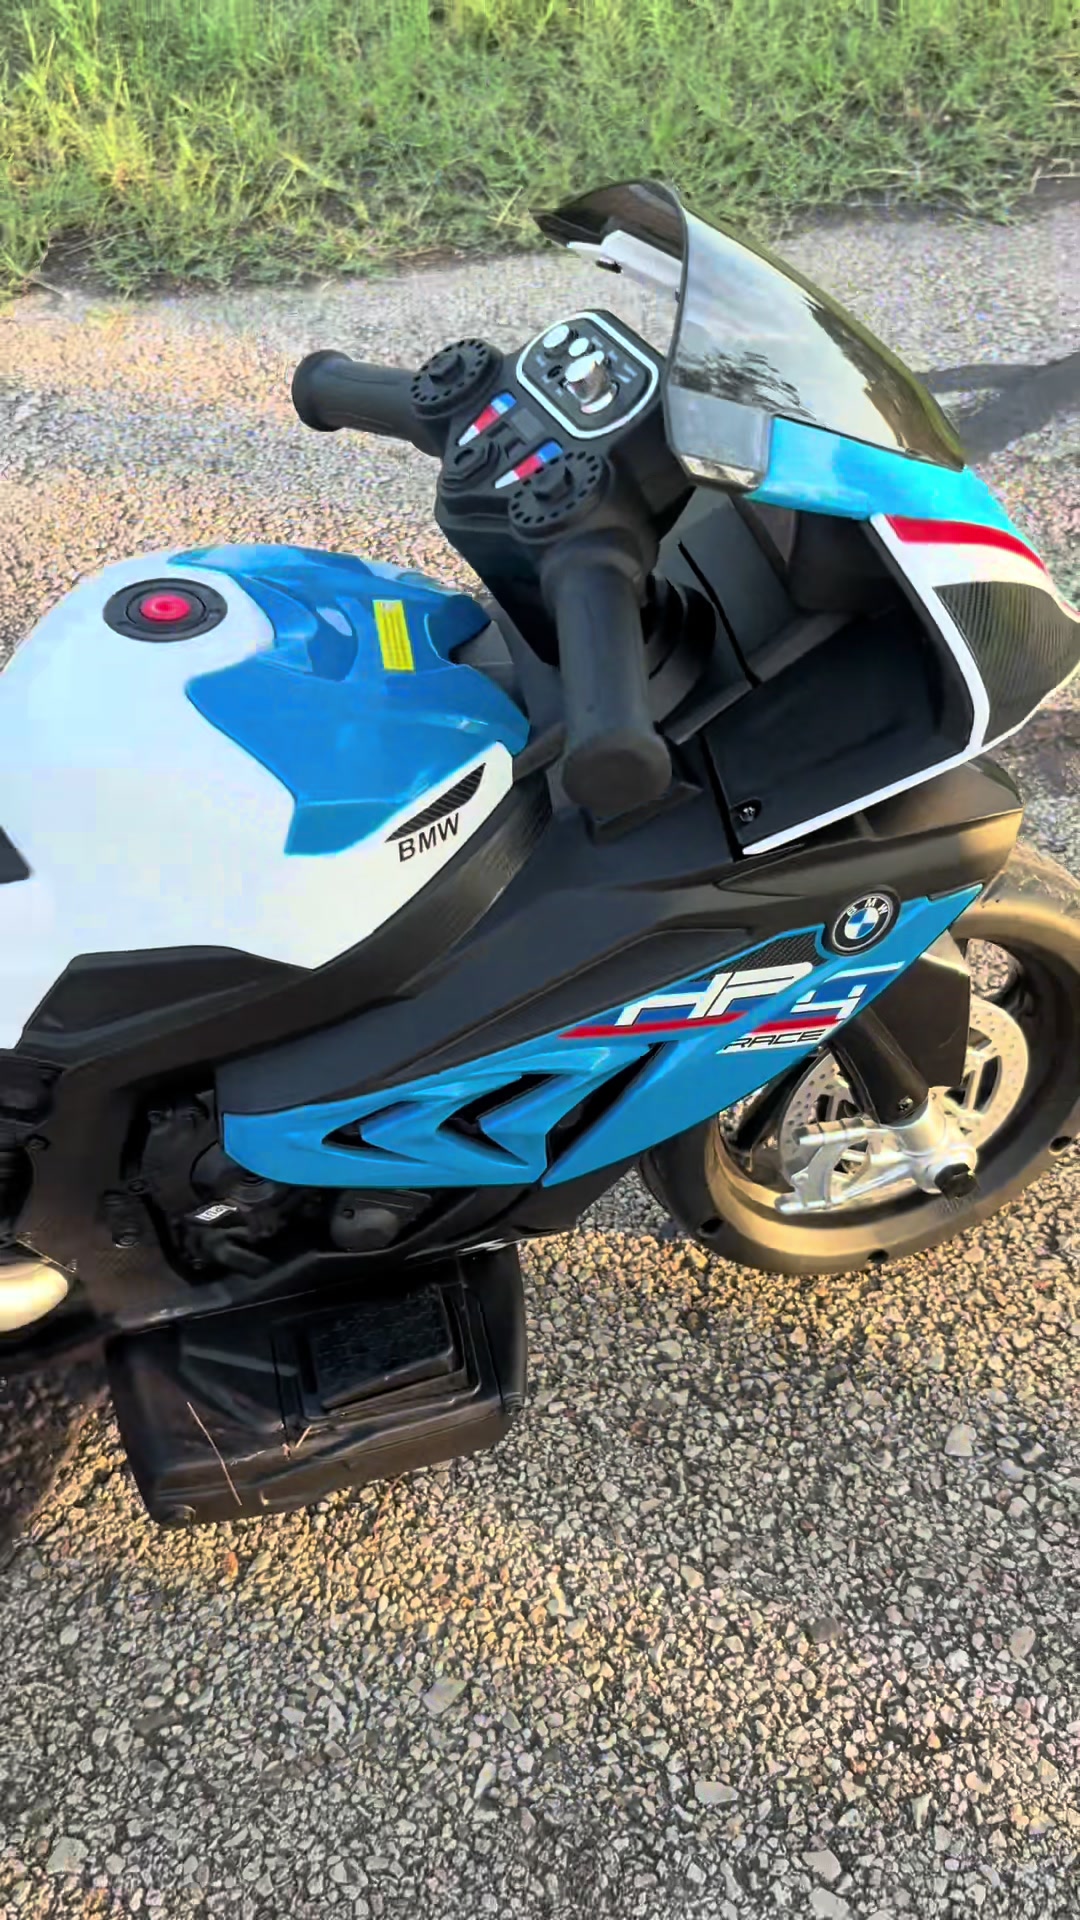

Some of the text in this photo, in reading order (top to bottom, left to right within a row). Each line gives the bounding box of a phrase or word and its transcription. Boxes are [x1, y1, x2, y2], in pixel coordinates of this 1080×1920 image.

[398, 812, 460, 862] BMW
[846, 897, 889, 917] BMW
[722, 1029, 827, 1050] RACE
